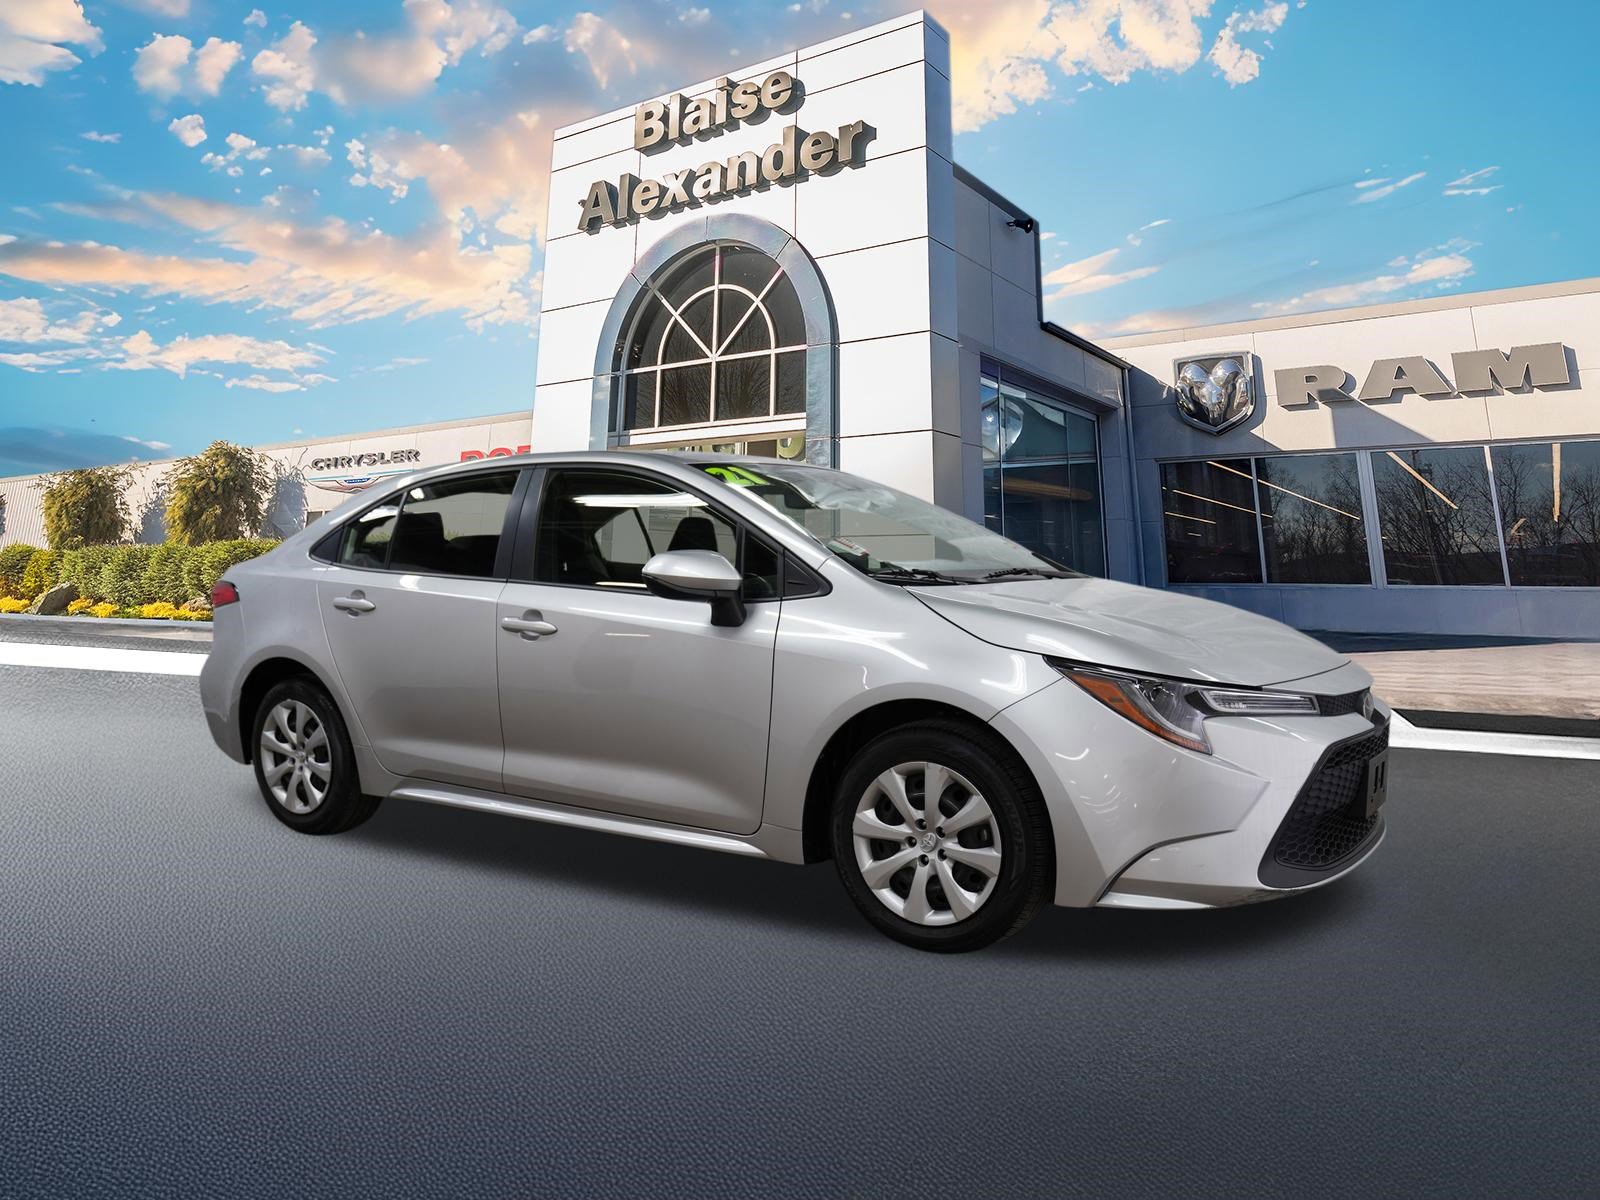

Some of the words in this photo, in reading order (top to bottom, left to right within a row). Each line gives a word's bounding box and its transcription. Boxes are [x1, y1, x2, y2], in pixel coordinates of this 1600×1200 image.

[634, 71, 798, 153] Blaise
[577, 120, 868, 230] Alexander
[1274, 342, 1570, 407] RAM
[312, 449, 420, 471] CHRYSLER
